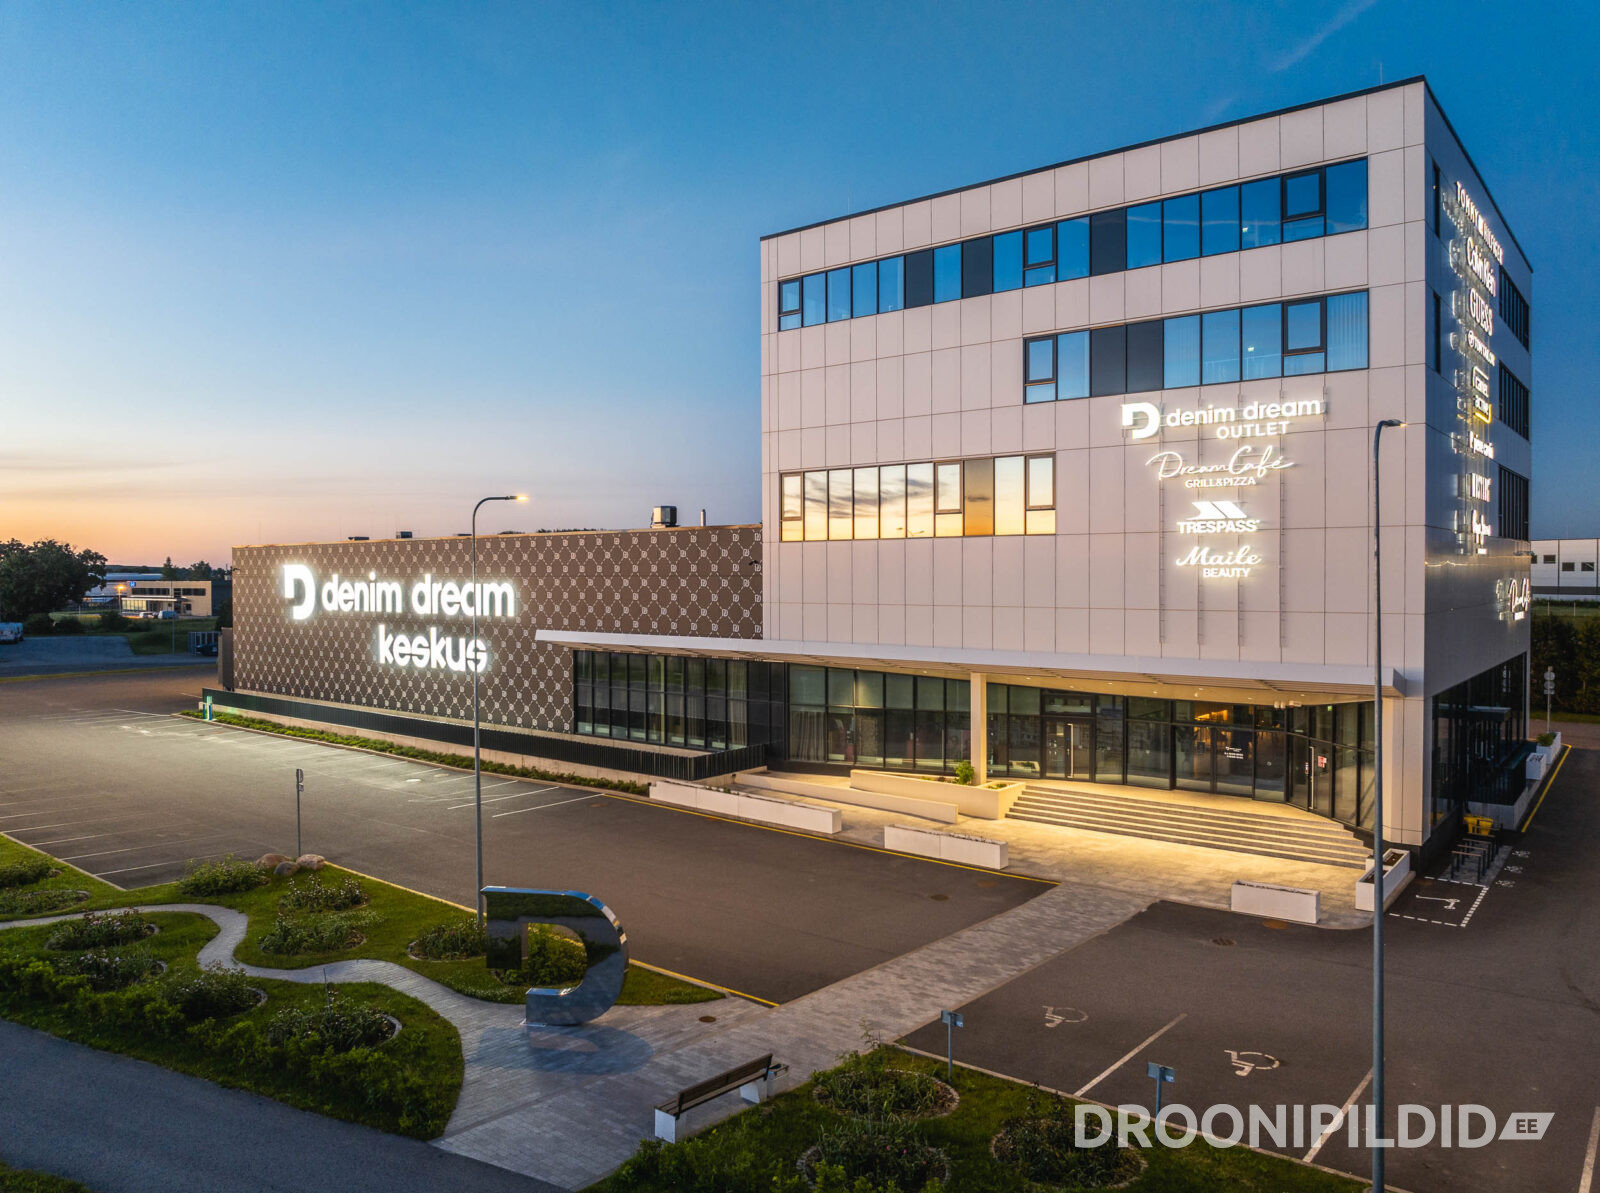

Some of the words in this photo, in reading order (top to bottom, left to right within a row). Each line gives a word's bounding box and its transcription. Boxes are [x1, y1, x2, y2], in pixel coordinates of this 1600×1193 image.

[1456, 181, 1479, 227] TOMMY
[1469, 288, 1493, 336] GUESS
[1166, 404, 1235, 427] denim
[1243, 399, 1320, 420] dream
[1216, 421, 1290, 440] OUTLET
[1185, 477, 1256, 489] GRILL&PIZZA
[1177, 521, 1258, 534] TRESPASS
[1176, 545, 1261, 567] Maile
[1203, 567, 1251, 578] BEAUTY
[322, 572, 402, 613] denim
[411, 574, 515, 617] dream
[378, 624, 488, 673] keskus
